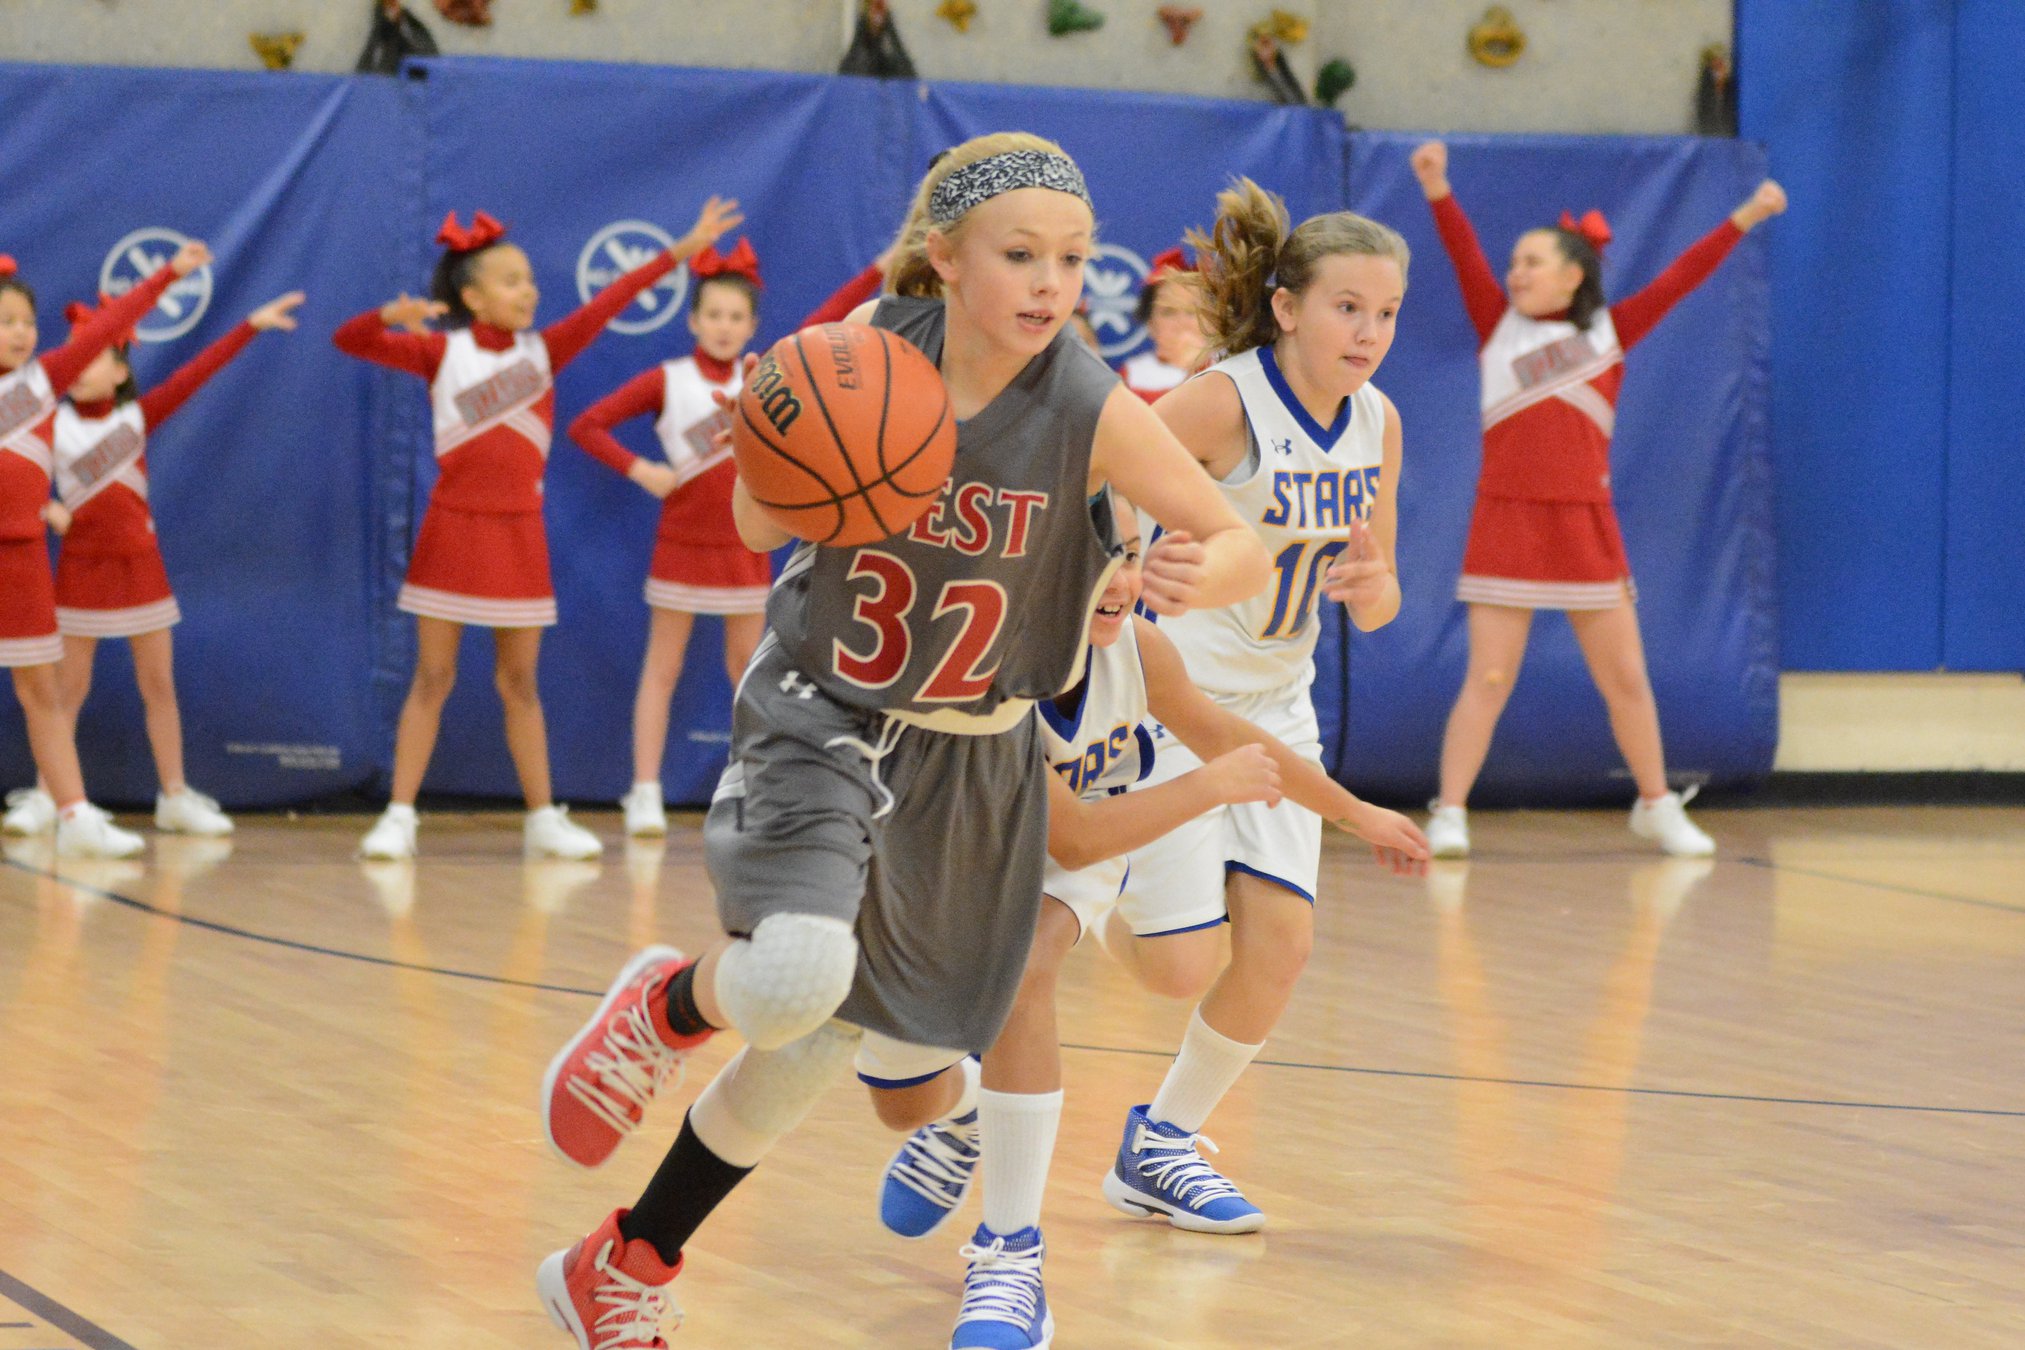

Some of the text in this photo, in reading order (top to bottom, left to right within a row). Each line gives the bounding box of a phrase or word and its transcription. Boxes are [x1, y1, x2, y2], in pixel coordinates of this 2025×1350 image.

[823, 321, 858, 390] EVOLU
[908, 476, 1048, 559] EST
[832, 549, 1008, 702] 32
